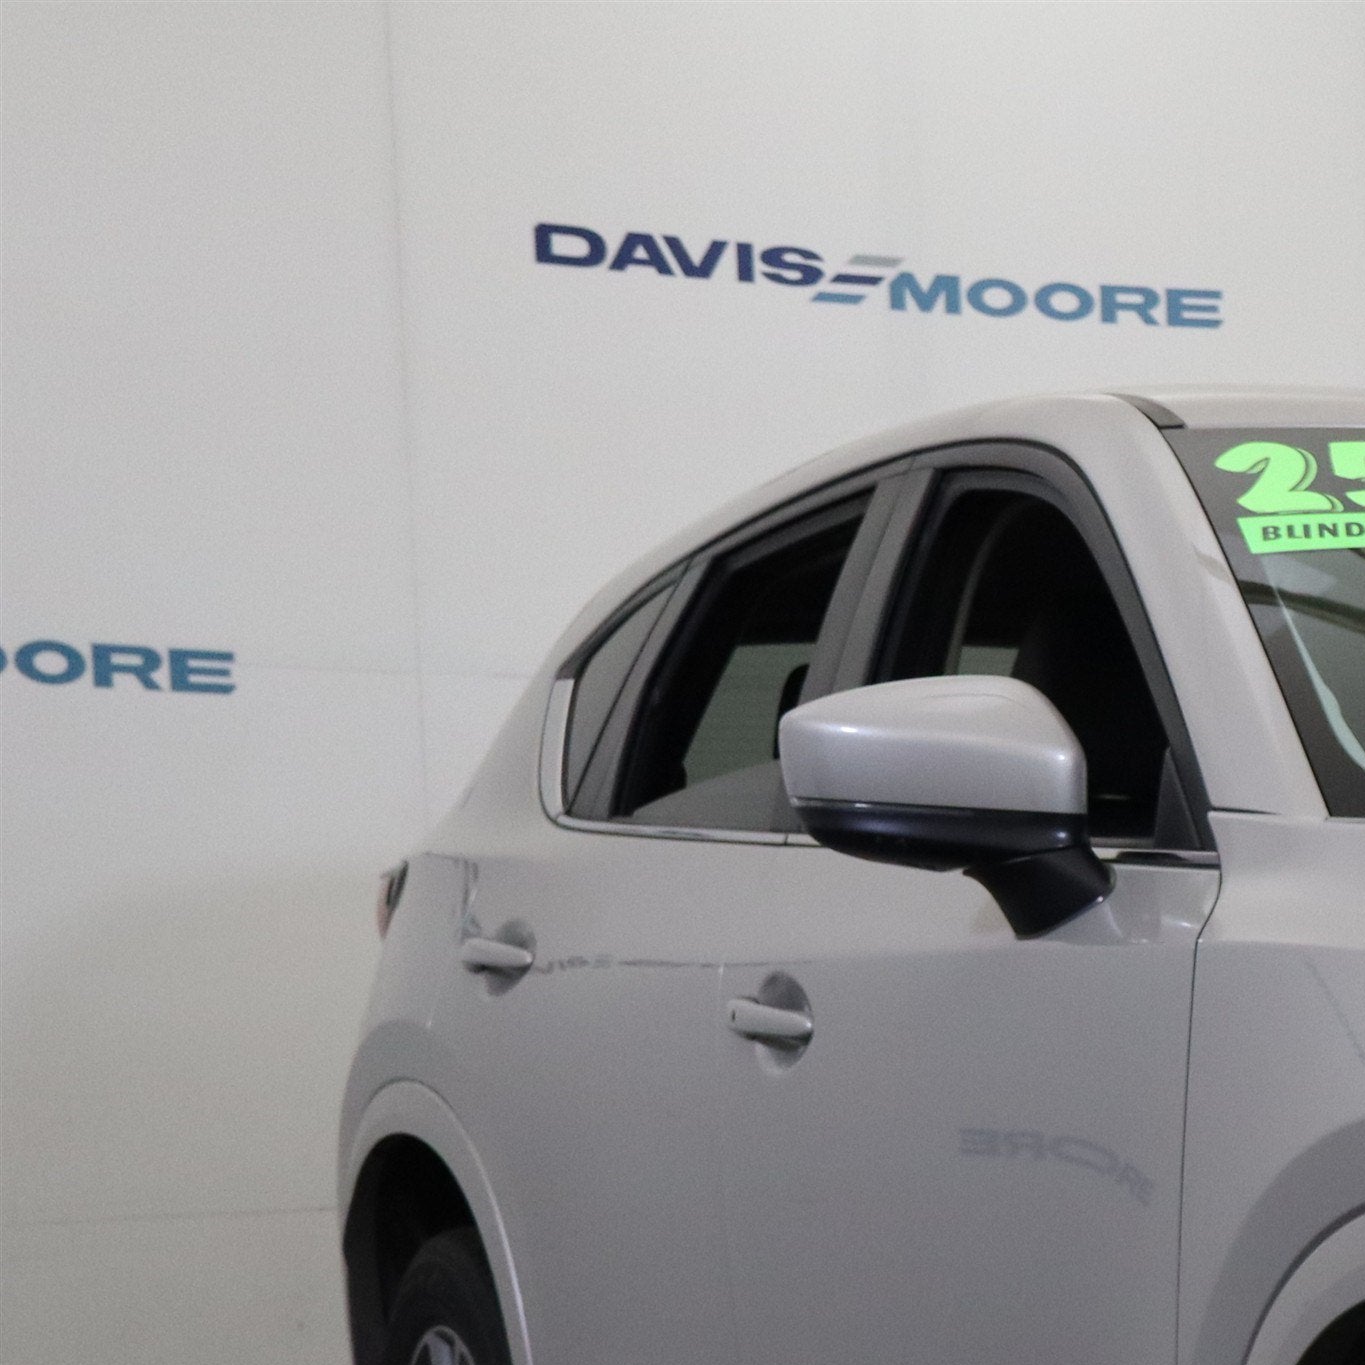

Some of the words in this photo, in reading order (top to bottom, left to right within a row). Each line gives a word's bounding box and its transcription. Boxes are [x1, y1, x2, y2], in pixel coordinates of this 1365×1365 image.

[533, 222, 825, 287] DAVIS
[888, 271, 1224, 329] MOORE
[1261, 520, 1365, 541] BLIND
[0, 639, 236, 695] ORE
